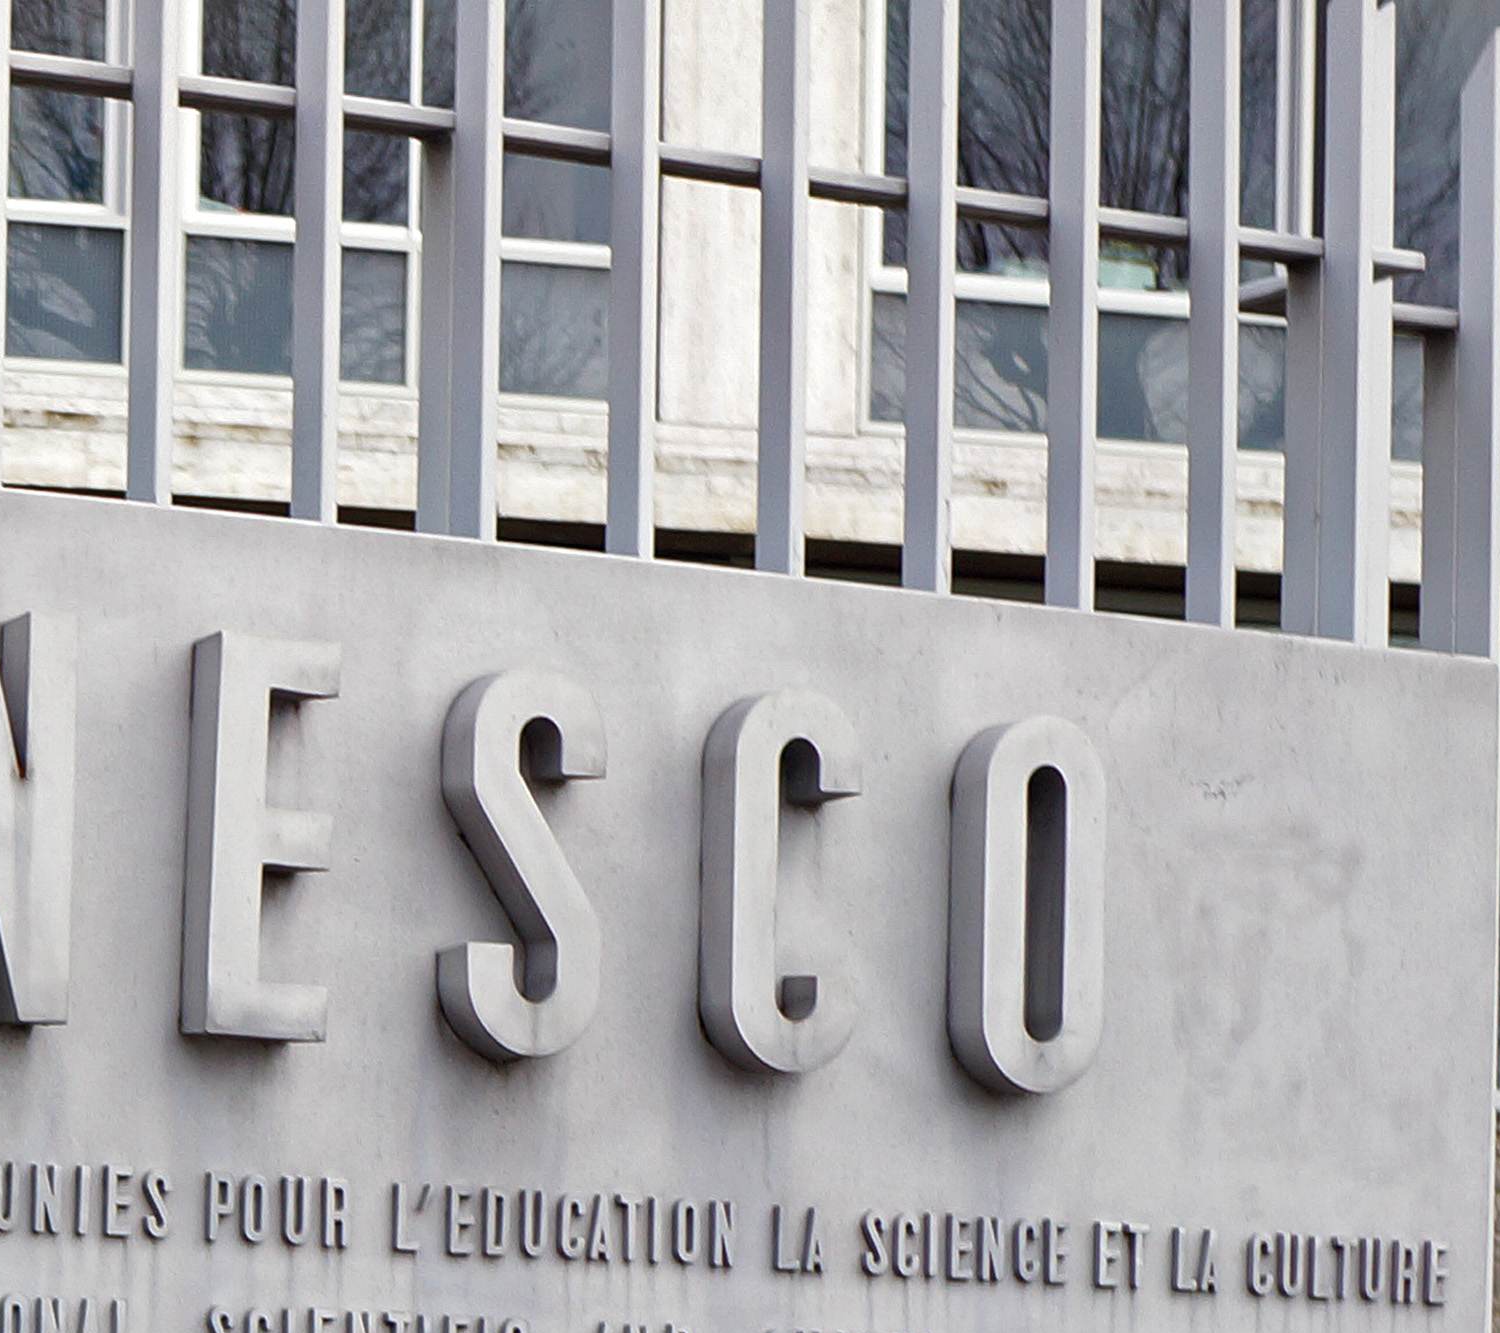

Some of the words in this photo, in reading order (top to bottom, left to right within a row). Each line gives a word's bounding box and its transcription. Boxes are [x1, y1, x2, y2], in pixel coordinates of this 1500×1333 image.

[203, 1168, 350, 1251] POUR
[390, 1182, 738, 1270] L'EDUCATION
[771, 1205, 825, 1275] LA
[859, 1210, 1068, 1288] SCIENCE
[1091, 1220, 1150, 1291] ET
[1171, 1226, 1220, 1294] LA
[1244, 1230, 1448, 1309] CULTURE
